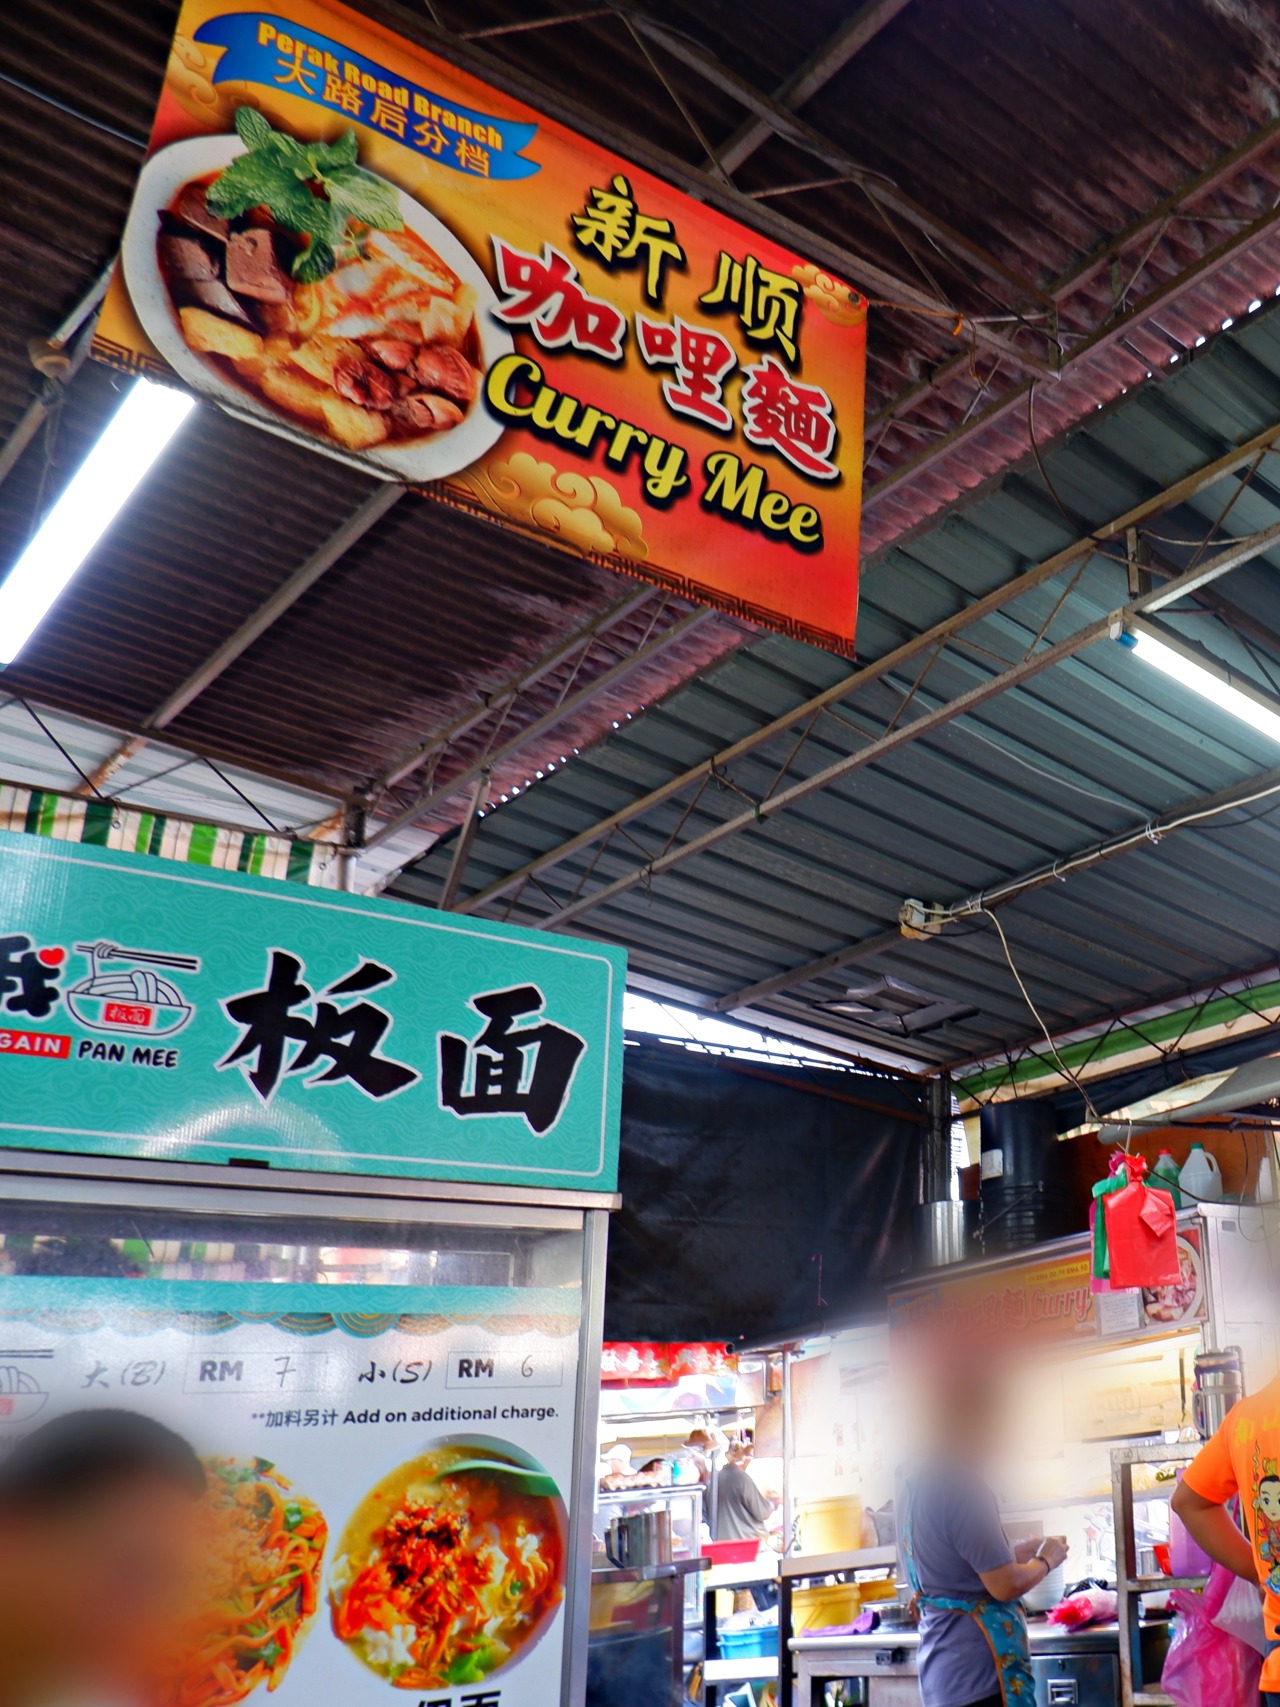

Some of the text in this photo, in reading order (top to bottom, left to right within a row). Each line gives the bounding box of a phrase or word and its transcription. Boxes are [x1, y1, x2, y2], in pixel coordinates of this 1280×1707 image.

[258, 21, 503, 151] Perak Road Branch
[273, 57, 491, 178] 大路后分档
[572, 175, 803, 361] 新顺
[491, 234, 839, 479] 咖哩麵
[485, 354, 821, 545] Curry Mee
[78, 1041, 125, 1062] PAN
[132, 1047, 178, 1068] MEE
[216, 948, 587, 1136] 板面
[1030, 1286, 1092, 1322] Curry
[200, 1356, 297, 1388] RM 7
[343, 1409, 380, 1425] Add
[385, 1411, 407, 1424] on
[411, 1407, 497, 1423] additional
[501, 1404, 559, 1421] charge.
[457, 1354, 534, 1379] RM 6
